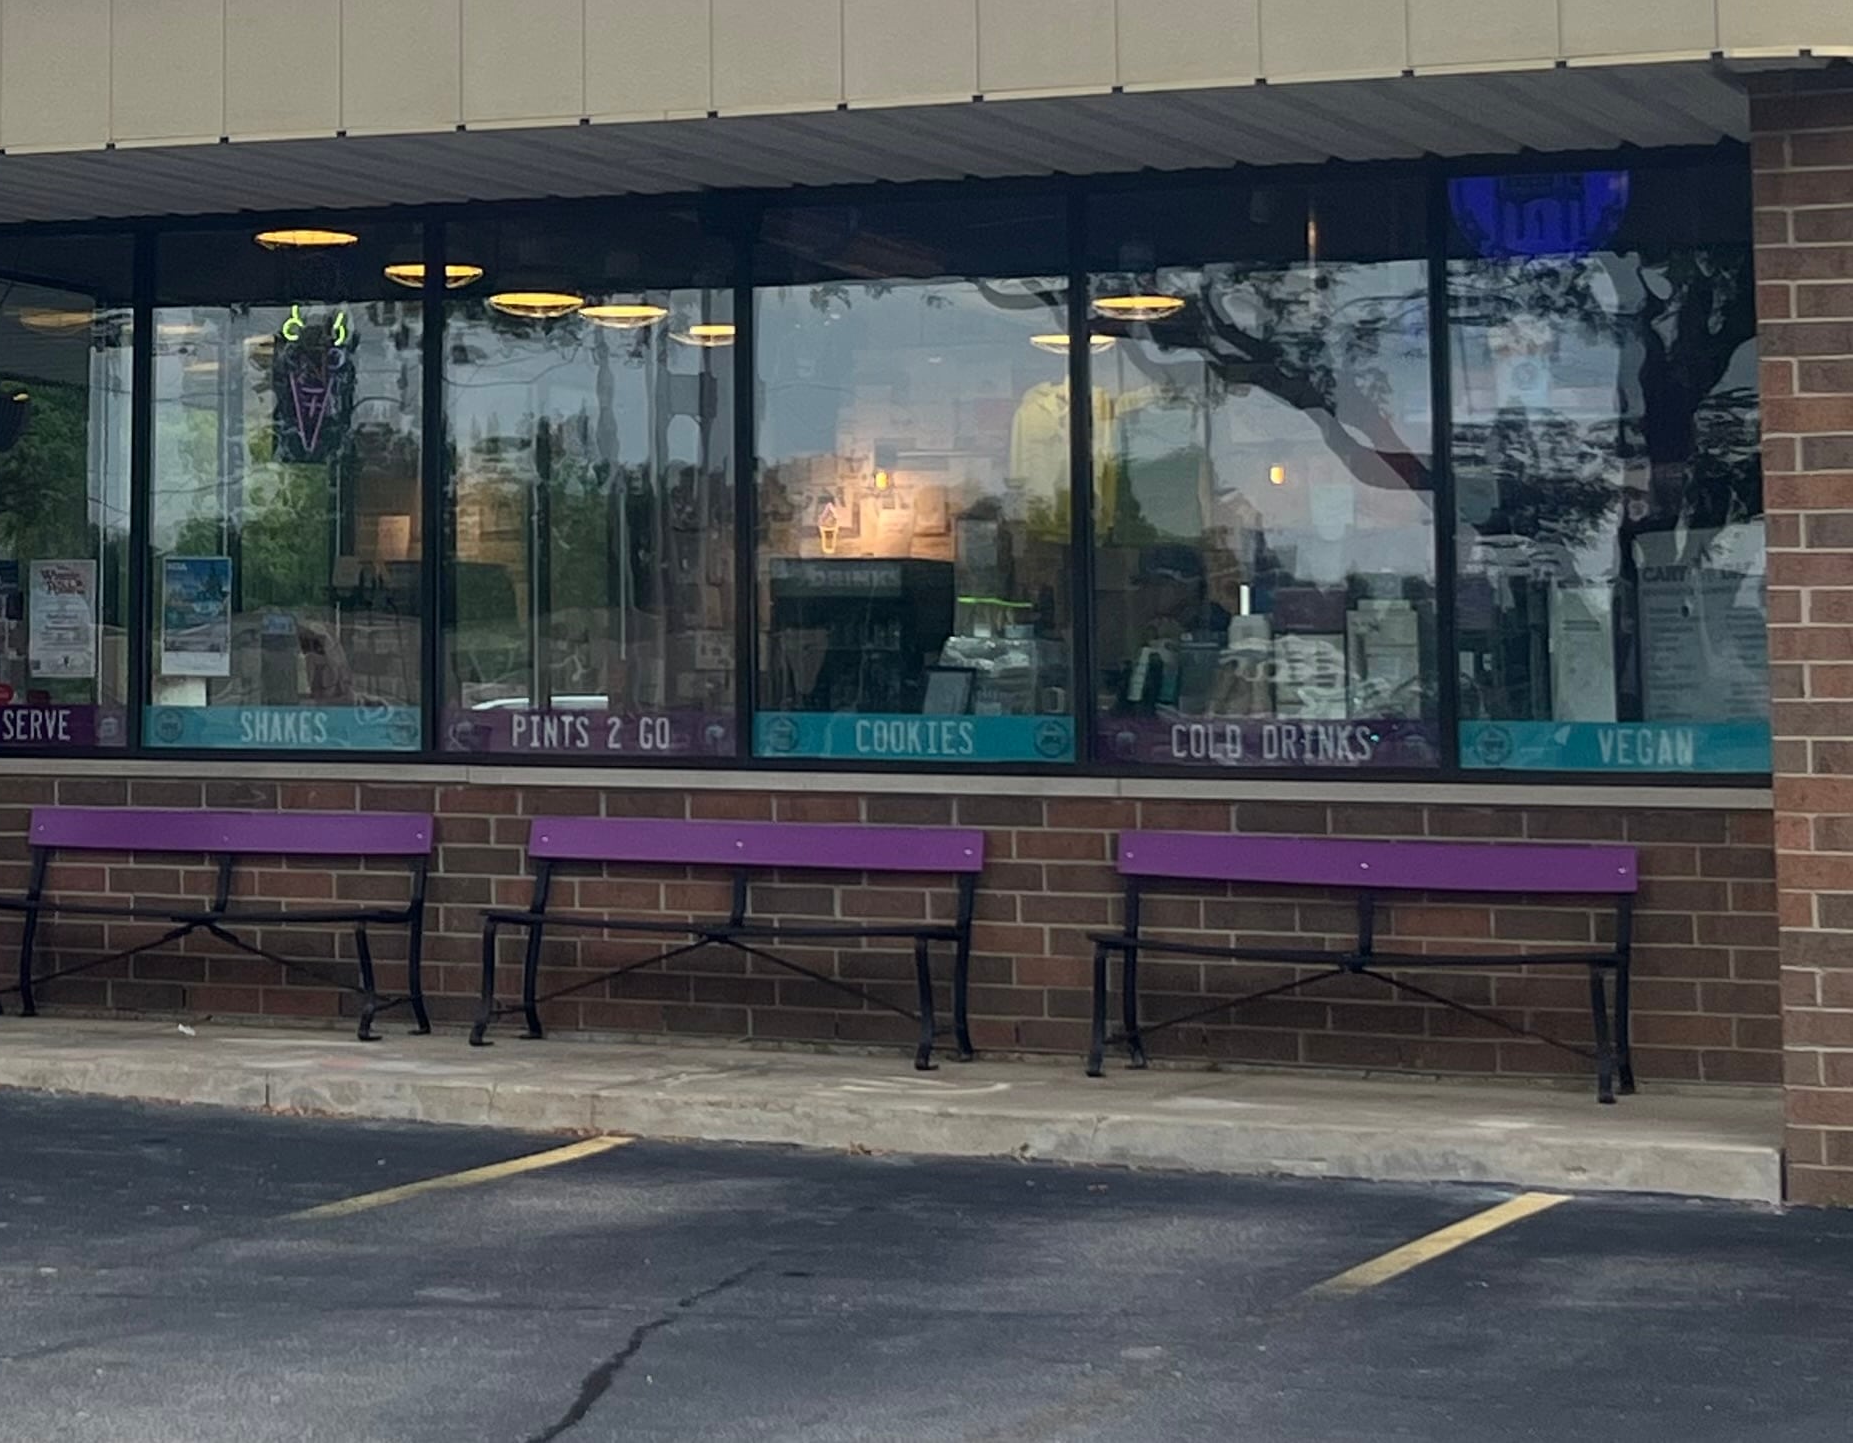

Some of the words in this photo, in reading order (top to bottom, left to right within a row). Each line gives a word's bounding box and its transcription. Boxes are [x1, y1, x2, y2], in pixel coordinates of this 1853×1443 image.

[2, 708, 72, 741] SERVE
[241, 711, 328, 744] SHAKES
[512, 714, 589, 749] PINTS
[608, 716, 622, 749] 2
[639, 717, 670, 749] GO
[855, 719, 974, 755] COOKIES
[1171, 724, 1242, 758] COLD
[1263, 725, 1373, 760] DRINKS
[1598, 728, 1695, 766] VEGAN
